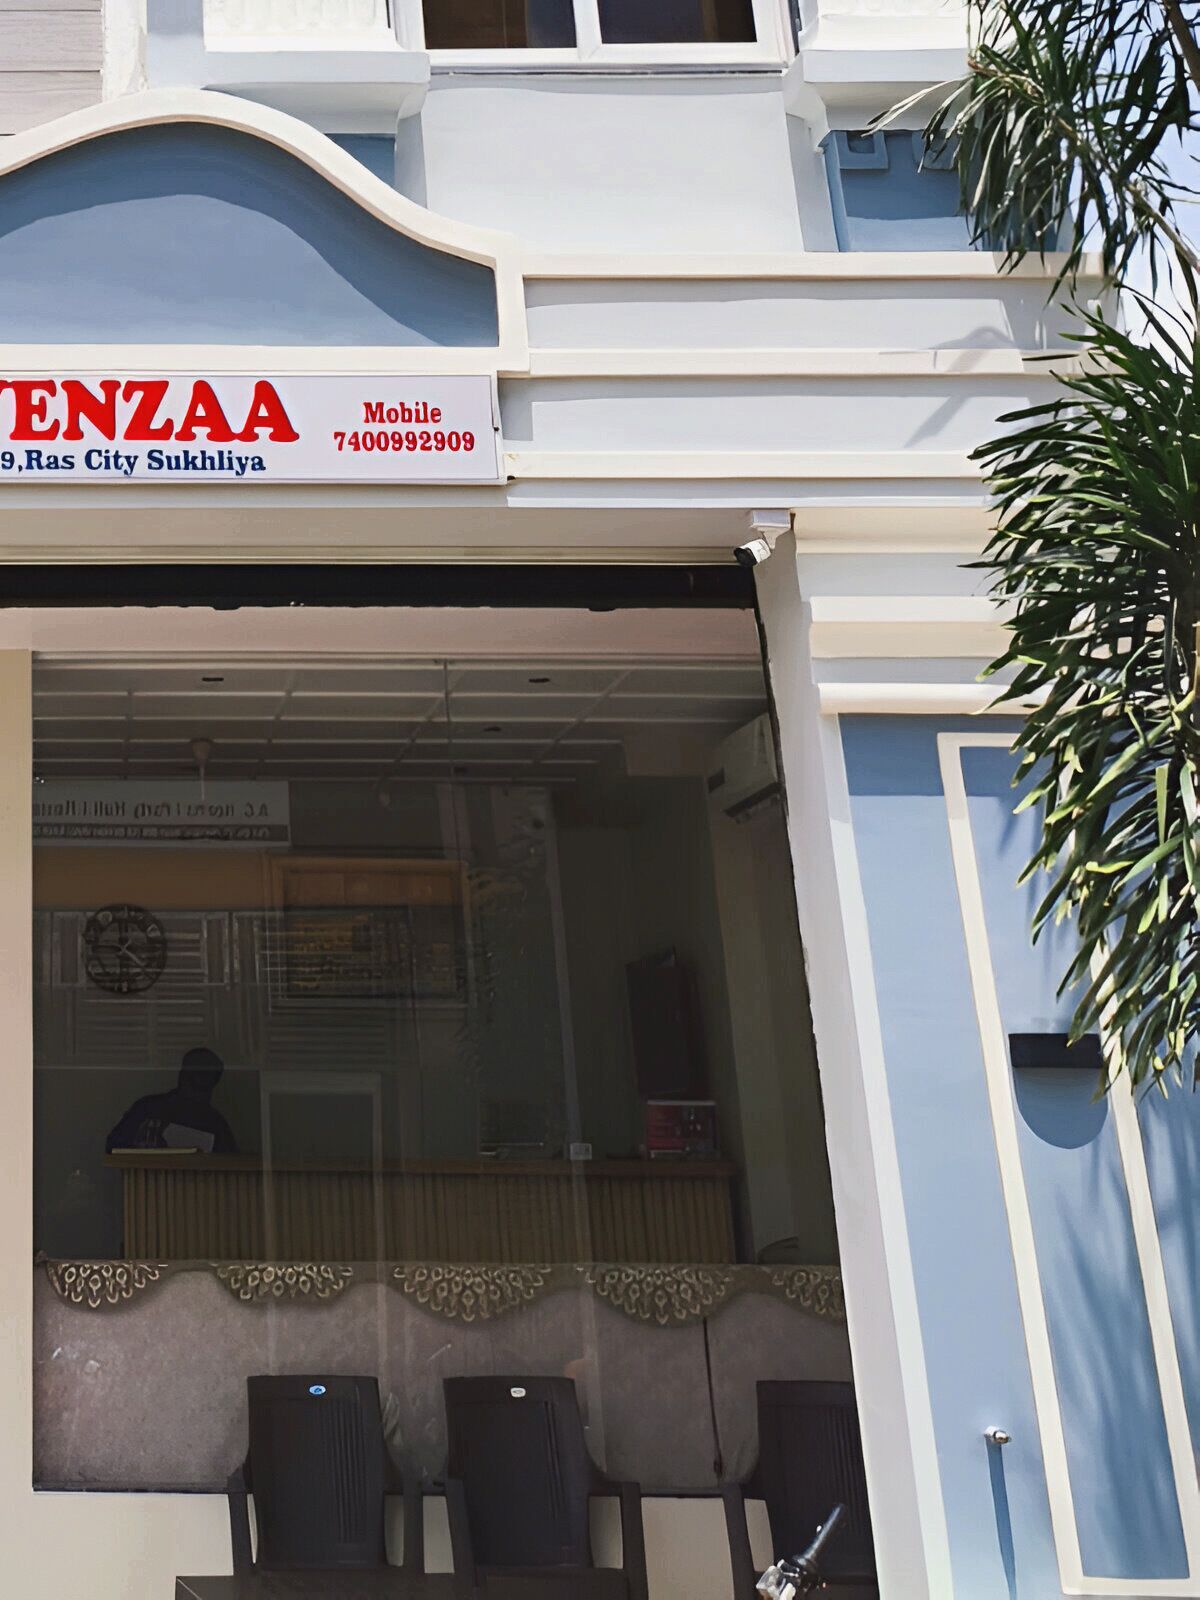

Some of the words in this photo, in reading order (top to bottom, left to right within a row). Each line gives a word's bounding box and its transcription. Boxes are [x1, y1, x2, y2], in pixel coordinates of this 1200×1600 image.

[362, 401, 442, 424] Mobile
[333, 431, 475, 452] 7400992909
[84, 449, 139, 476] City
[147, 449, 266, 476] Sukhliya
